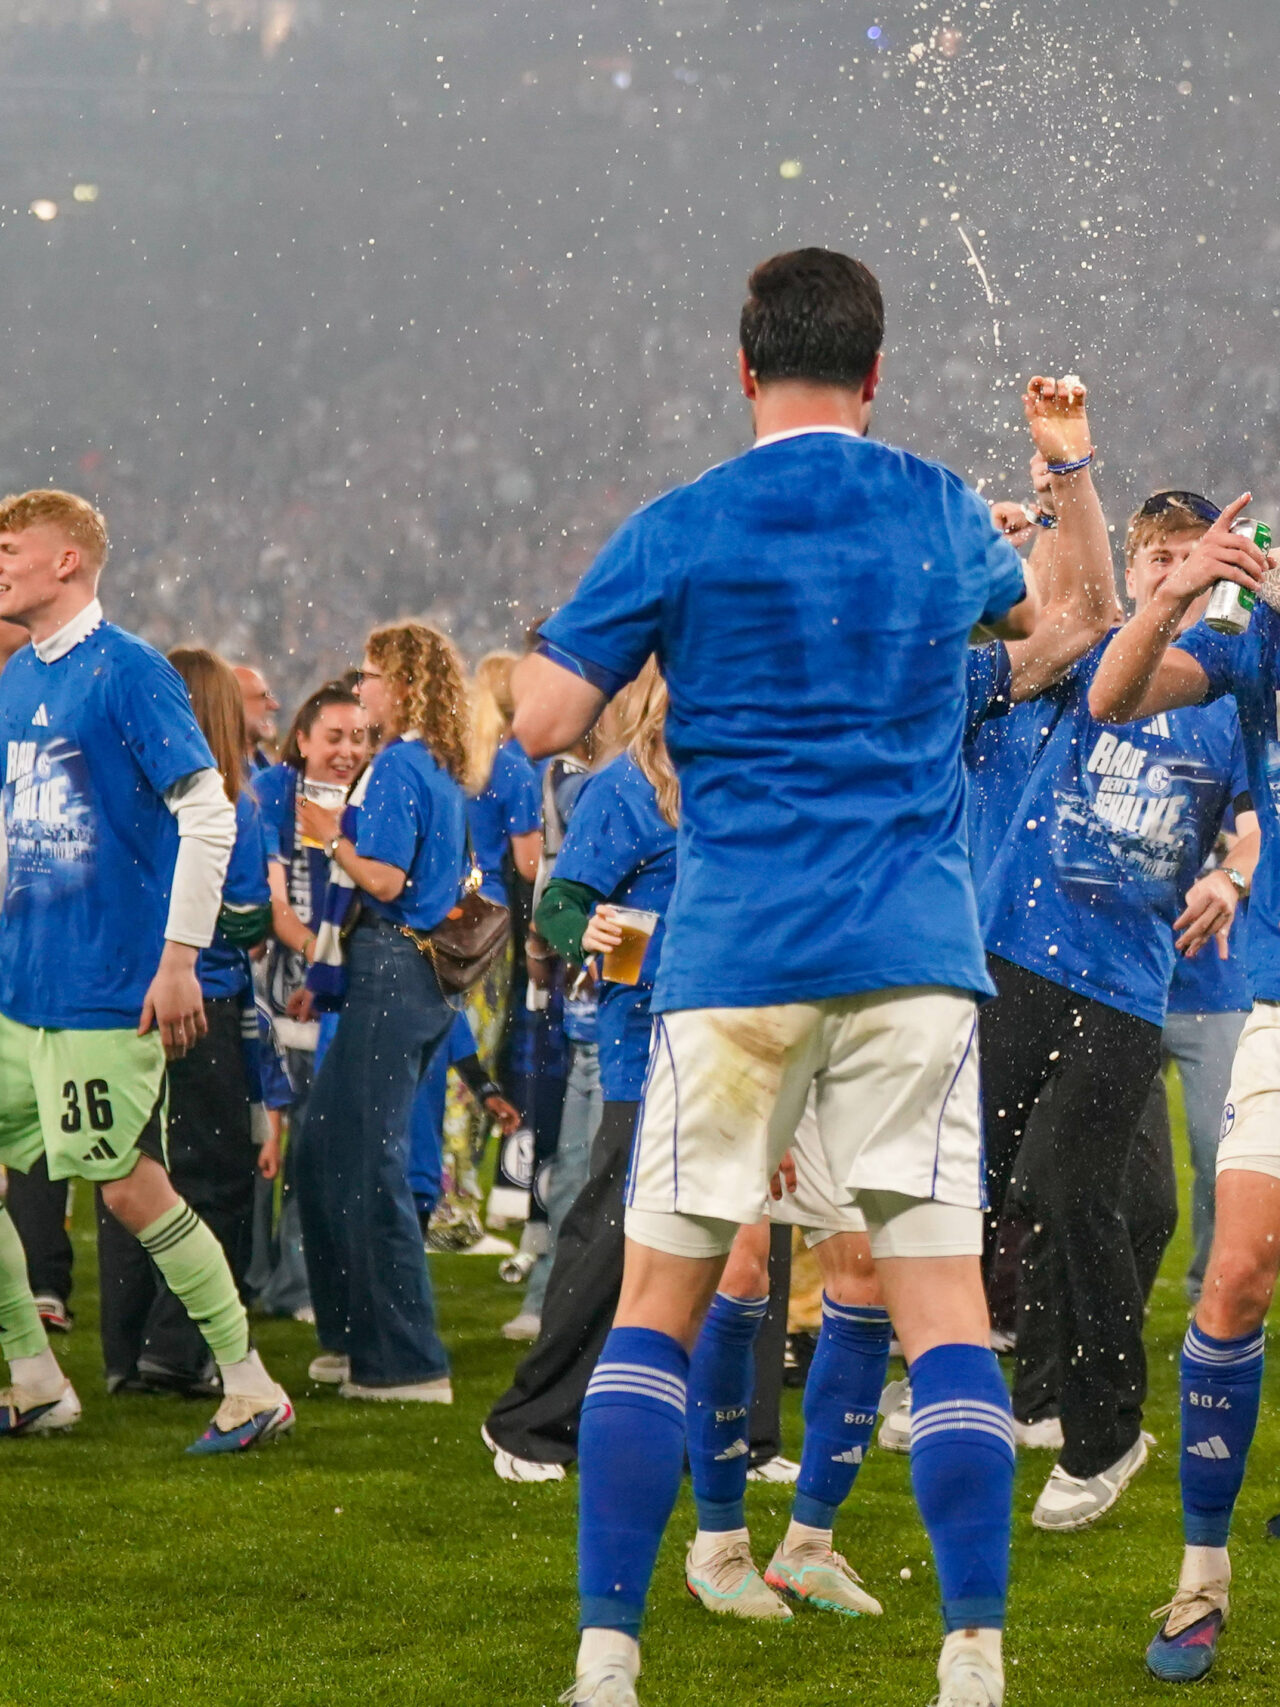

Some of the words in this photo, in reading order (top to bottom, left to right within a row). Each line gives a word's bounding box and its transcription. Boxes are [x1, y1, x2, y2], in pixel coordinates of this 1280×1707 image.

[1087, 731, 1147, 779] RAUF
[1093, 791, 1187, 845] SCHALKE
[61, 1078, 114, 1133] 36
[1189, 1391, 1231, 1410] S04
